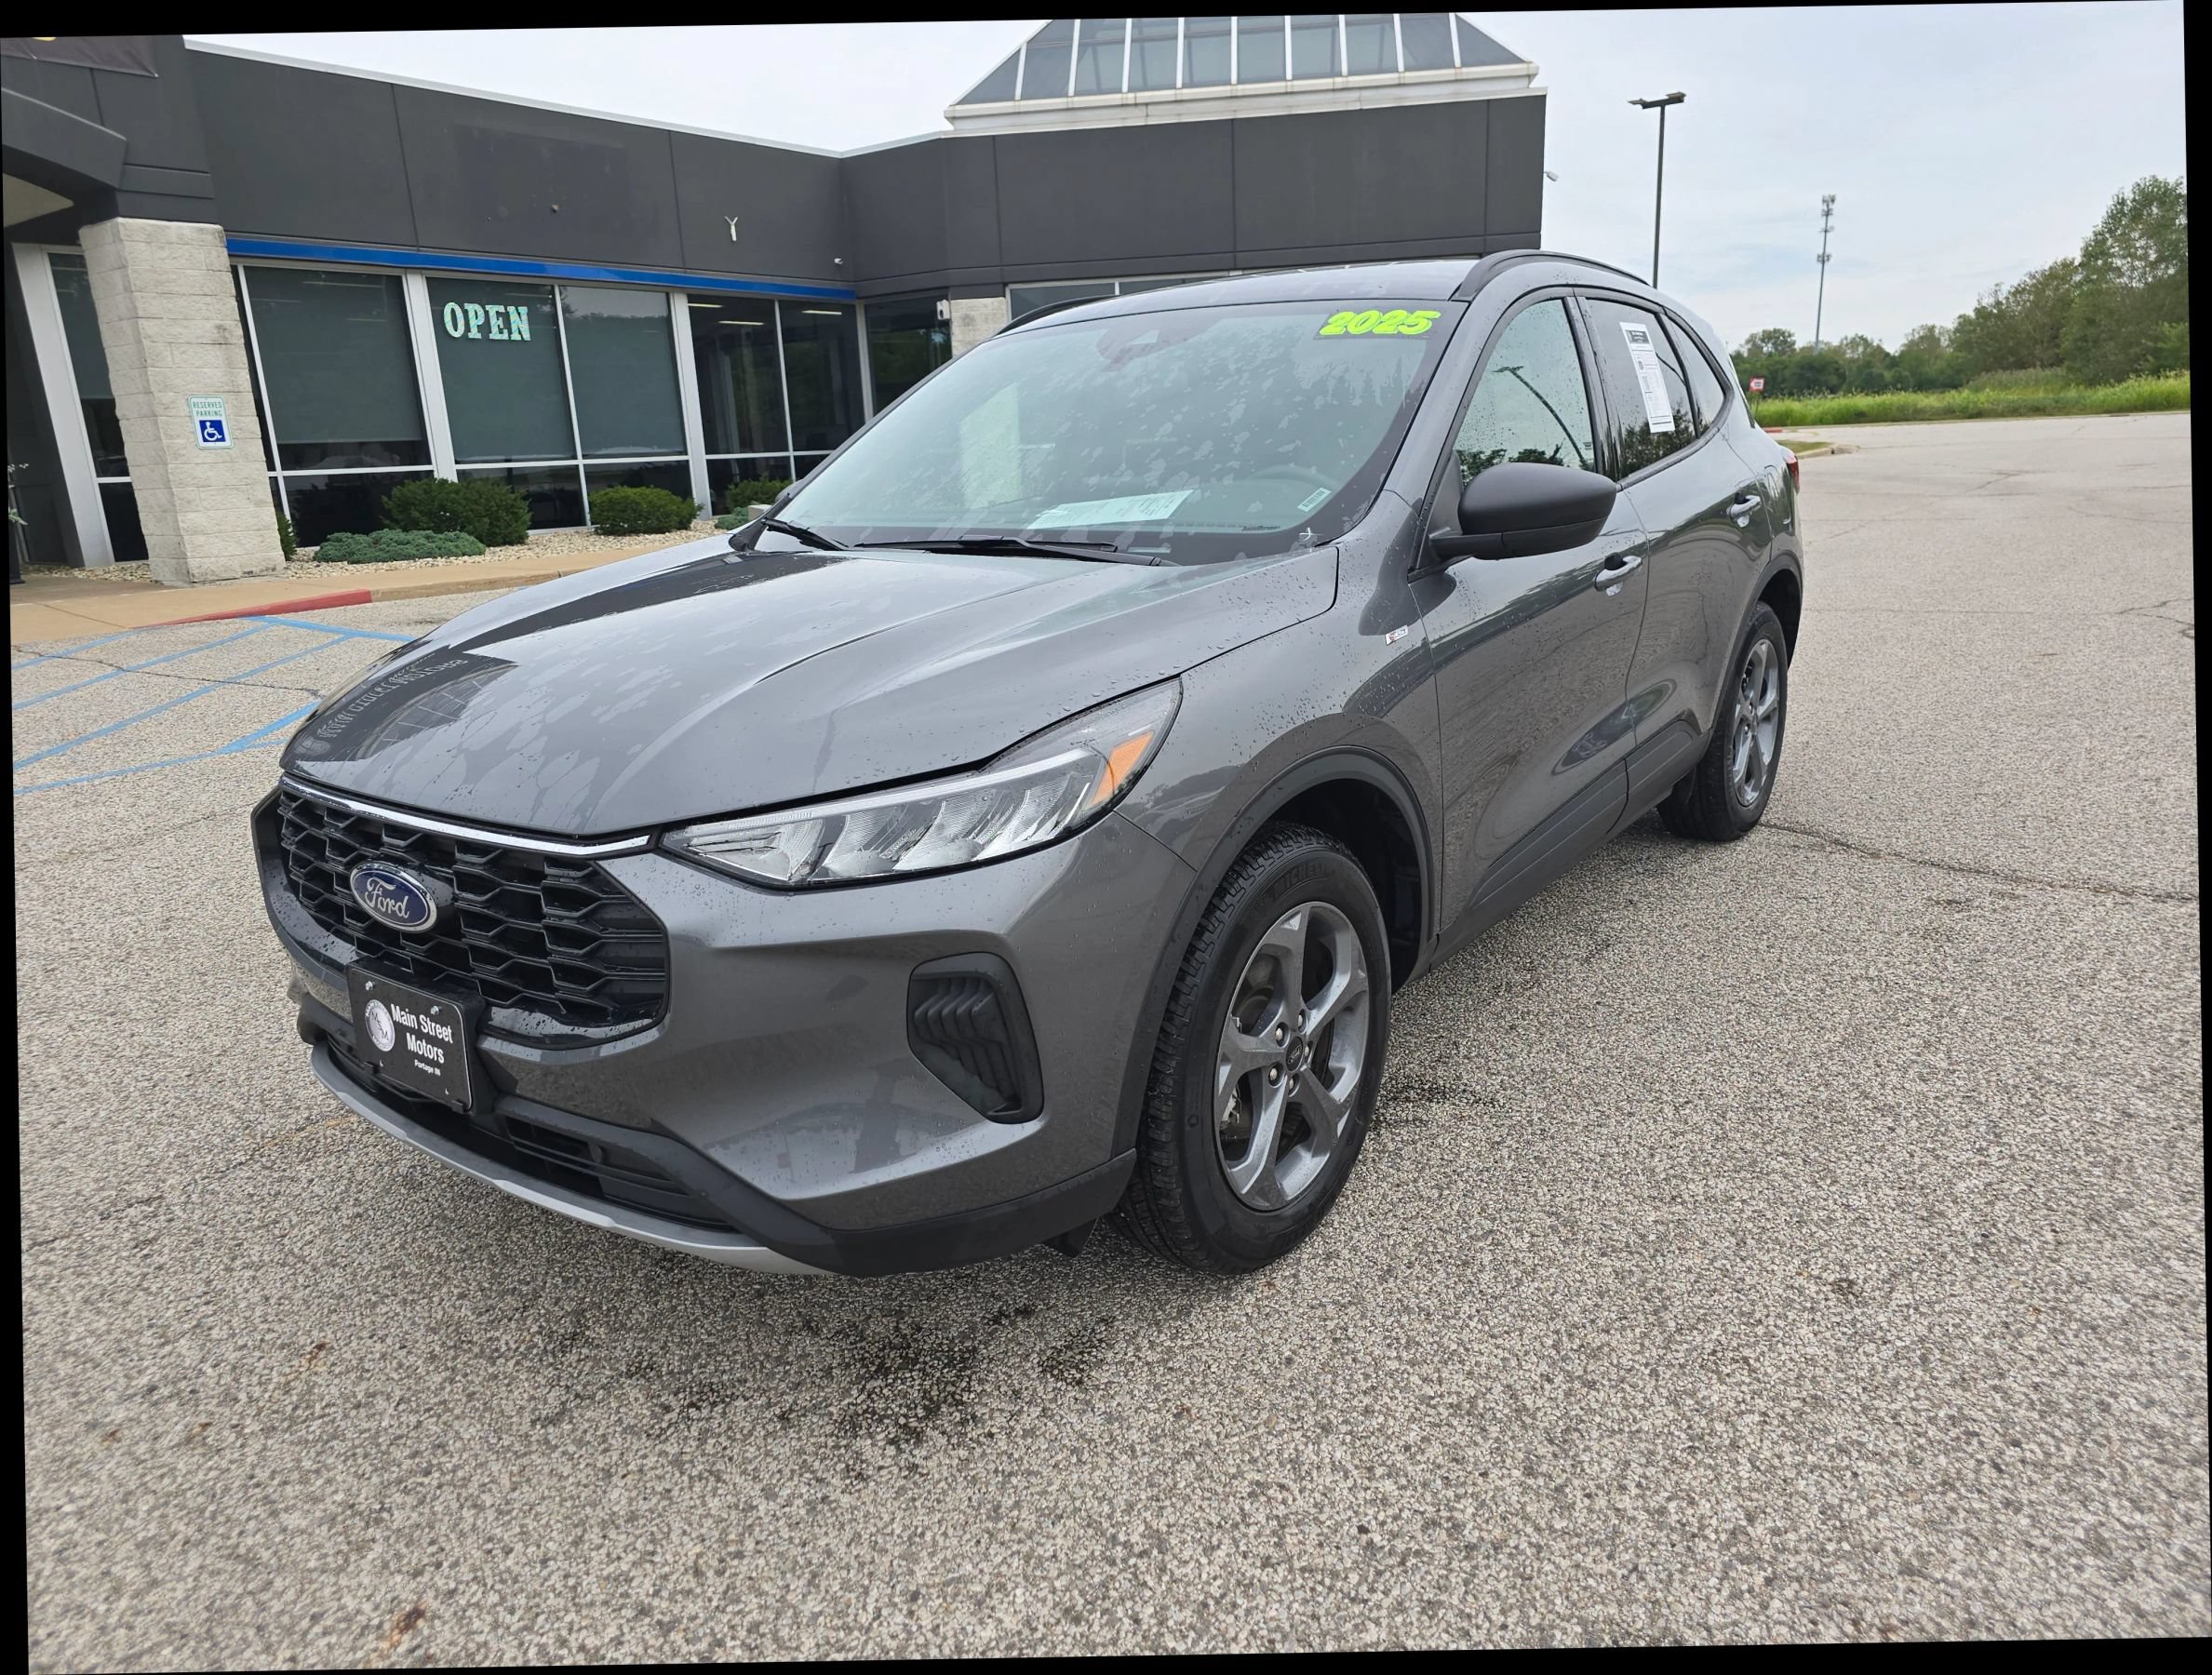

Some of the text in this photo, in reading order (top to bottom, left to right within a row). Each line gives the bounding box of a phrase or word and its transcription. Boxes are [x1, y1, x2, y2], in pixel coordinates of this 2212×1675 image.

[444, 302, 530, 341] OPEN
[1319, 309, 1441, 335] 2025
[364, 876, 409, 919] Ford
[391, 1003, 418, 1030] Main
[419, 1014, 453, 1044] Street
[406, 1032, 445, 1064] Motors
